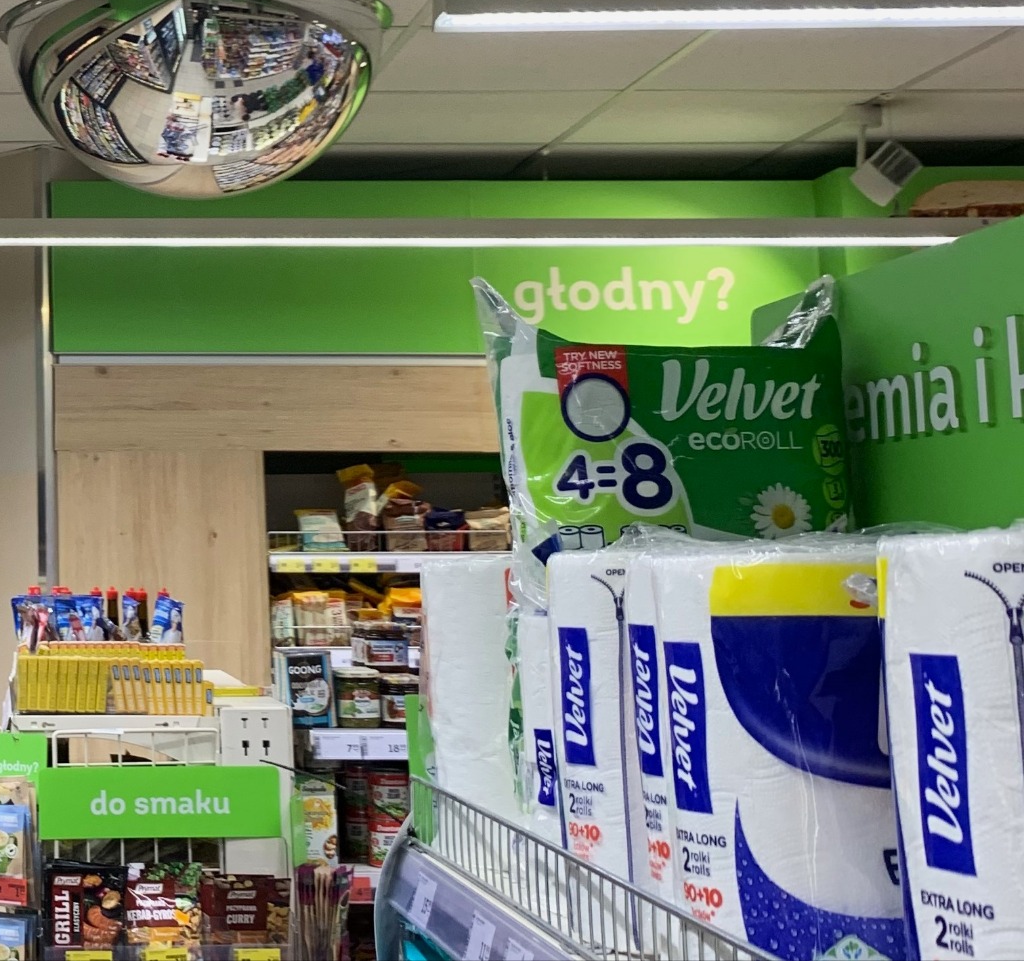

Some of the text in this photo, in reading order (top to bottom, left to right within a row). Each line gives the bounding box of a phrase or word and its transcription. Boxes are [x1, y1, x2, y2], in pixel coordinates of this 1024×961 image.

[514, 266, 735, 326] głodny?
[561, 361, 622, 372] SOFTNESS
[563, 351, 618, 361] TRY NEW
[973, 326, 989, 423] i
[661, 358, 822, 422] Velvet
[688, 430, 804, 451] ecoROLL
[557, 442, 673, 510] 4=8
[288, 664, 322, 675] GOONG
[565, 643, 587, 747] Velvet
[633, 642, 656, 756] Velvet
[668, 663, 699, 793] Velvet
[537, 739, 556, 797] Velvet
[924, 678, 964, 844] Velvet
[581, 781, 604, 792] LONG
[90, 789, 231, 816] do smaku
[568, 793, 593, 814] 2 rolki
[576, 805, 593, 817] rolls
[696, 833, 727, 848] LONG
[682, 846, 691, 873] 2
[690, 850, 711, 866] rolki
[690, 863, 711, 877] rolls
[54, 889, 71, 946] GRILL
[920, 889, 995, 921] EXTRA LONG
[227, 913, 255, 925] CURRY
[935, 915, 974, 950] 2 rolki
[949, 939, 975, 957] rolls
